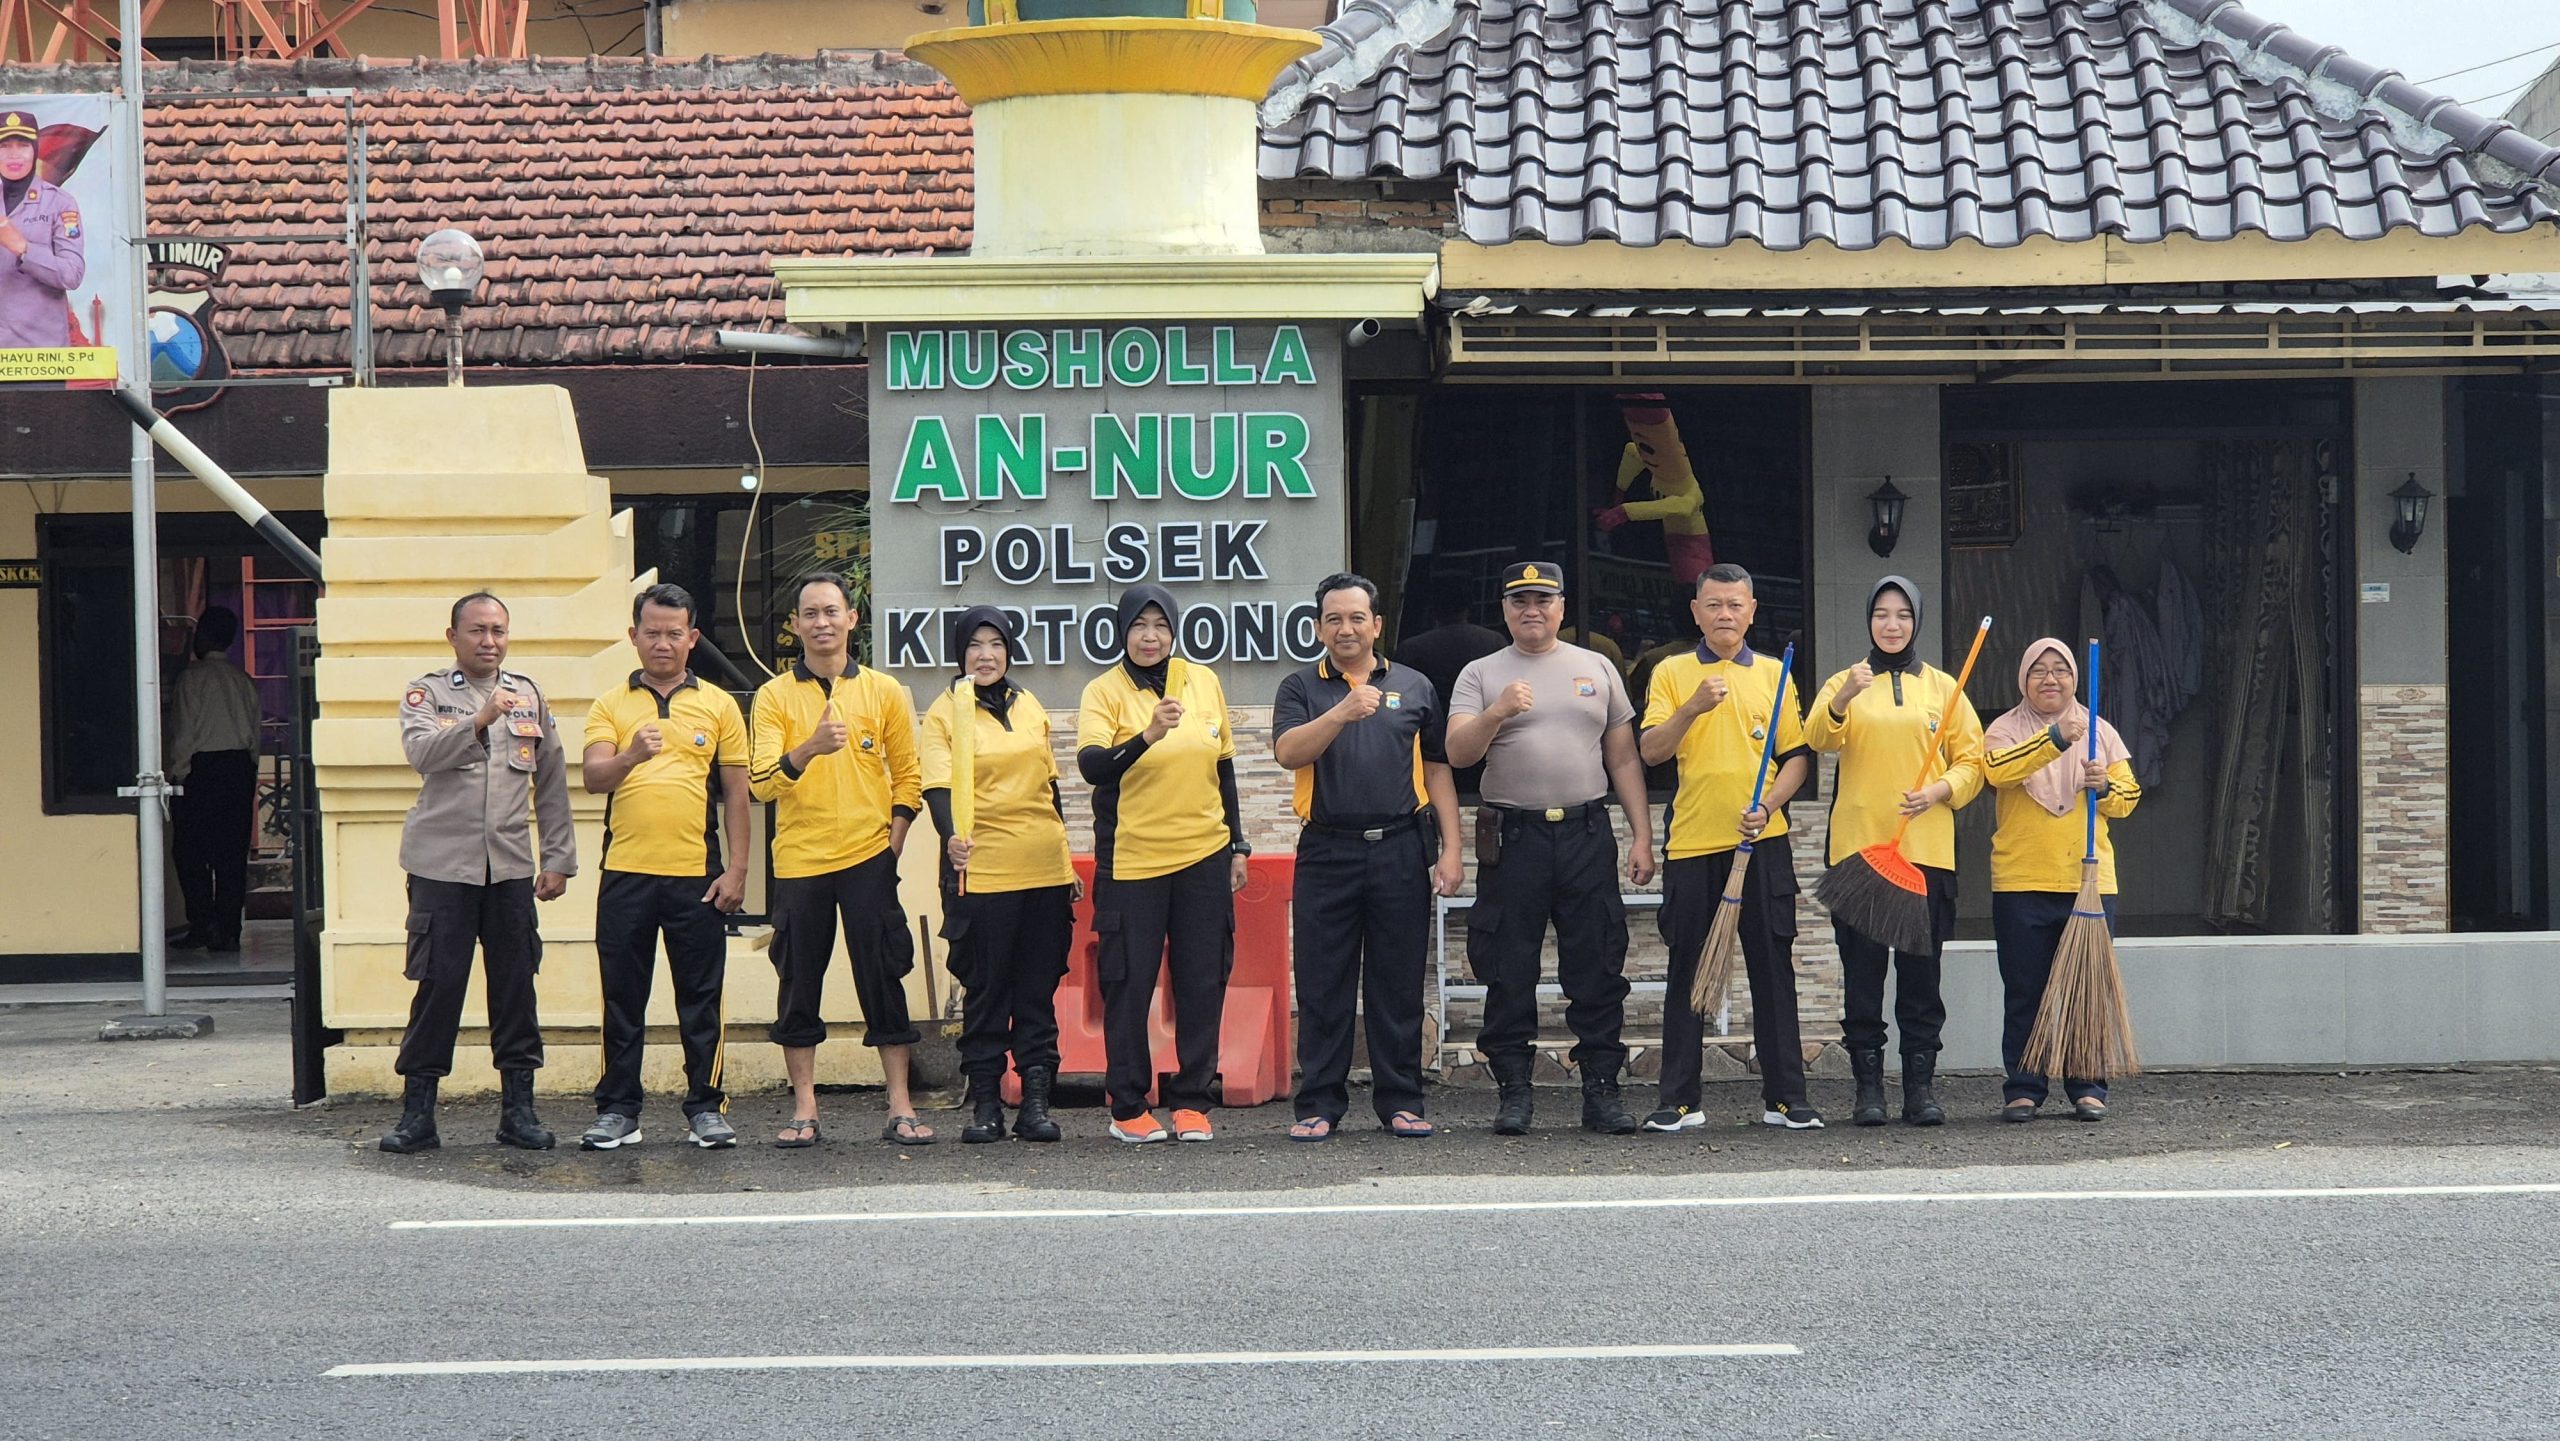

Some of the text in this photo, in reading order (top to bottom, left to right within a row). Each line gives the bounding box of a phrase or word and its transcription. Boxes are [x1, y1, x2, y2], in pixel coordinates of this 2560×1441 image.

[37, 352, 64, 363] RINI,
[67, 352, 94, 362] S.Pd
[886, 325, 1317, 390] MUSHOLLA
[890, 411, 1317, 503] AN-NUR
[940, 519, 1268, 586] POLSEK
